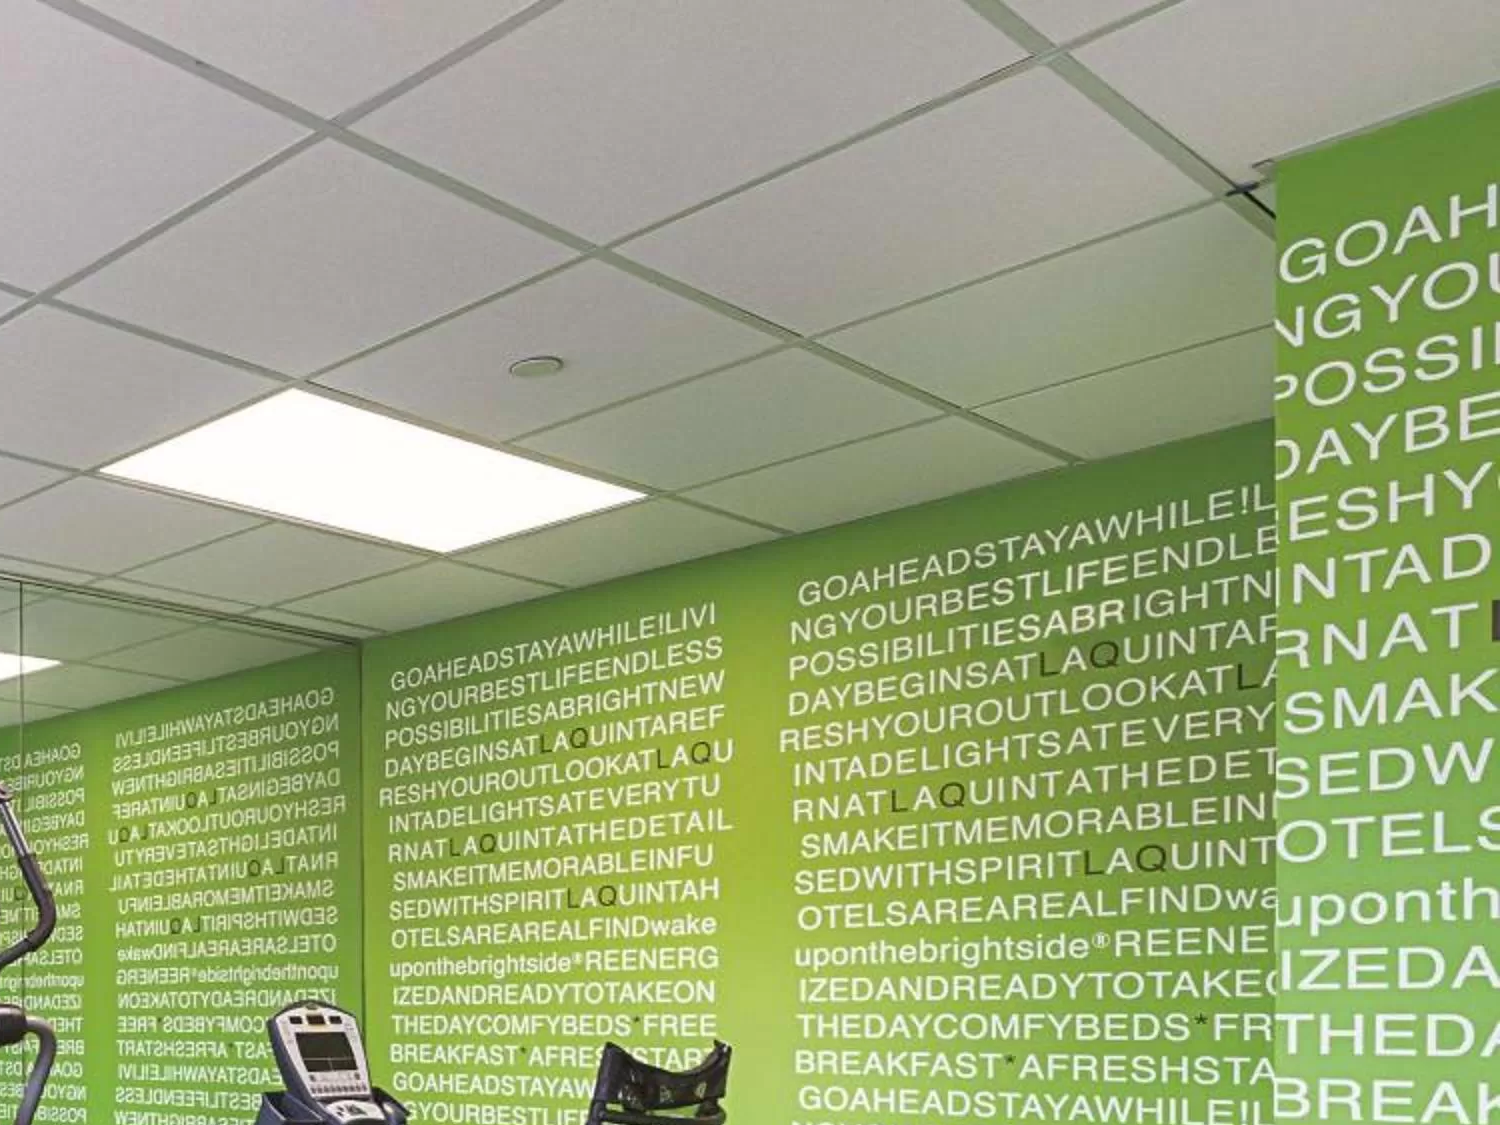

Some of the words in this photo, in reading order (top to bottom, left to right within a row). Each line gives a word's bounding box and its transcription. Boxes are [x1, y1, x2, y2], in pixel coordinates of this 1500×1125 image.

[1279, 183, 1498, 284] GOAH
[1274, 252, 1500, 348] NGYO
[1274, 320, 1500, 407] POSSI
[1276, 461, 1500, 542] ESHY
[790, 526, 1277, 644] NGYOURBESTLIFEENDLE
[789, 569, 1272, 681] POSSIBILITIESABRIGHTN
[385, 670, 725, 750] POSSIBILITIESABRIGHTNEW
[386, 637, 723, 721] NGYOURBESTLIFEENDLESS
[1283, 667, 1500, 735] SMAK
[379, 739, 733, 808] RESHYOUROUTLOOKATLAQU
[385, 704, 726, 778] DAYBEGINSATLAQUINTAREF
[794, 702, 1275, 786] INTADELIGHTSATEVERY
[1275, 737, 1494, 800] SEDW
[388, 809, 733, 863] RNATLAQUINTATHEDETAIL
[389, 774, 721, 833] INTADELIGHTSATEVERYTU
[801, 791, 1277, 859] SMAKEITMEMORABLEIN
[389, 877, 719, 921] SEDWITHSPIRITLAQUINTAH
[393, 844, 713, 892] SMAKEITMEMORABLEINFU
[794, 836, 1276, 895] SEDWITHSPIRITLAQUINT
[391, 914, 717, 949] OTELSAREAREALFINDwake
[393, 980, 716, 1006] IZEDANDREADYTOTAKEON
